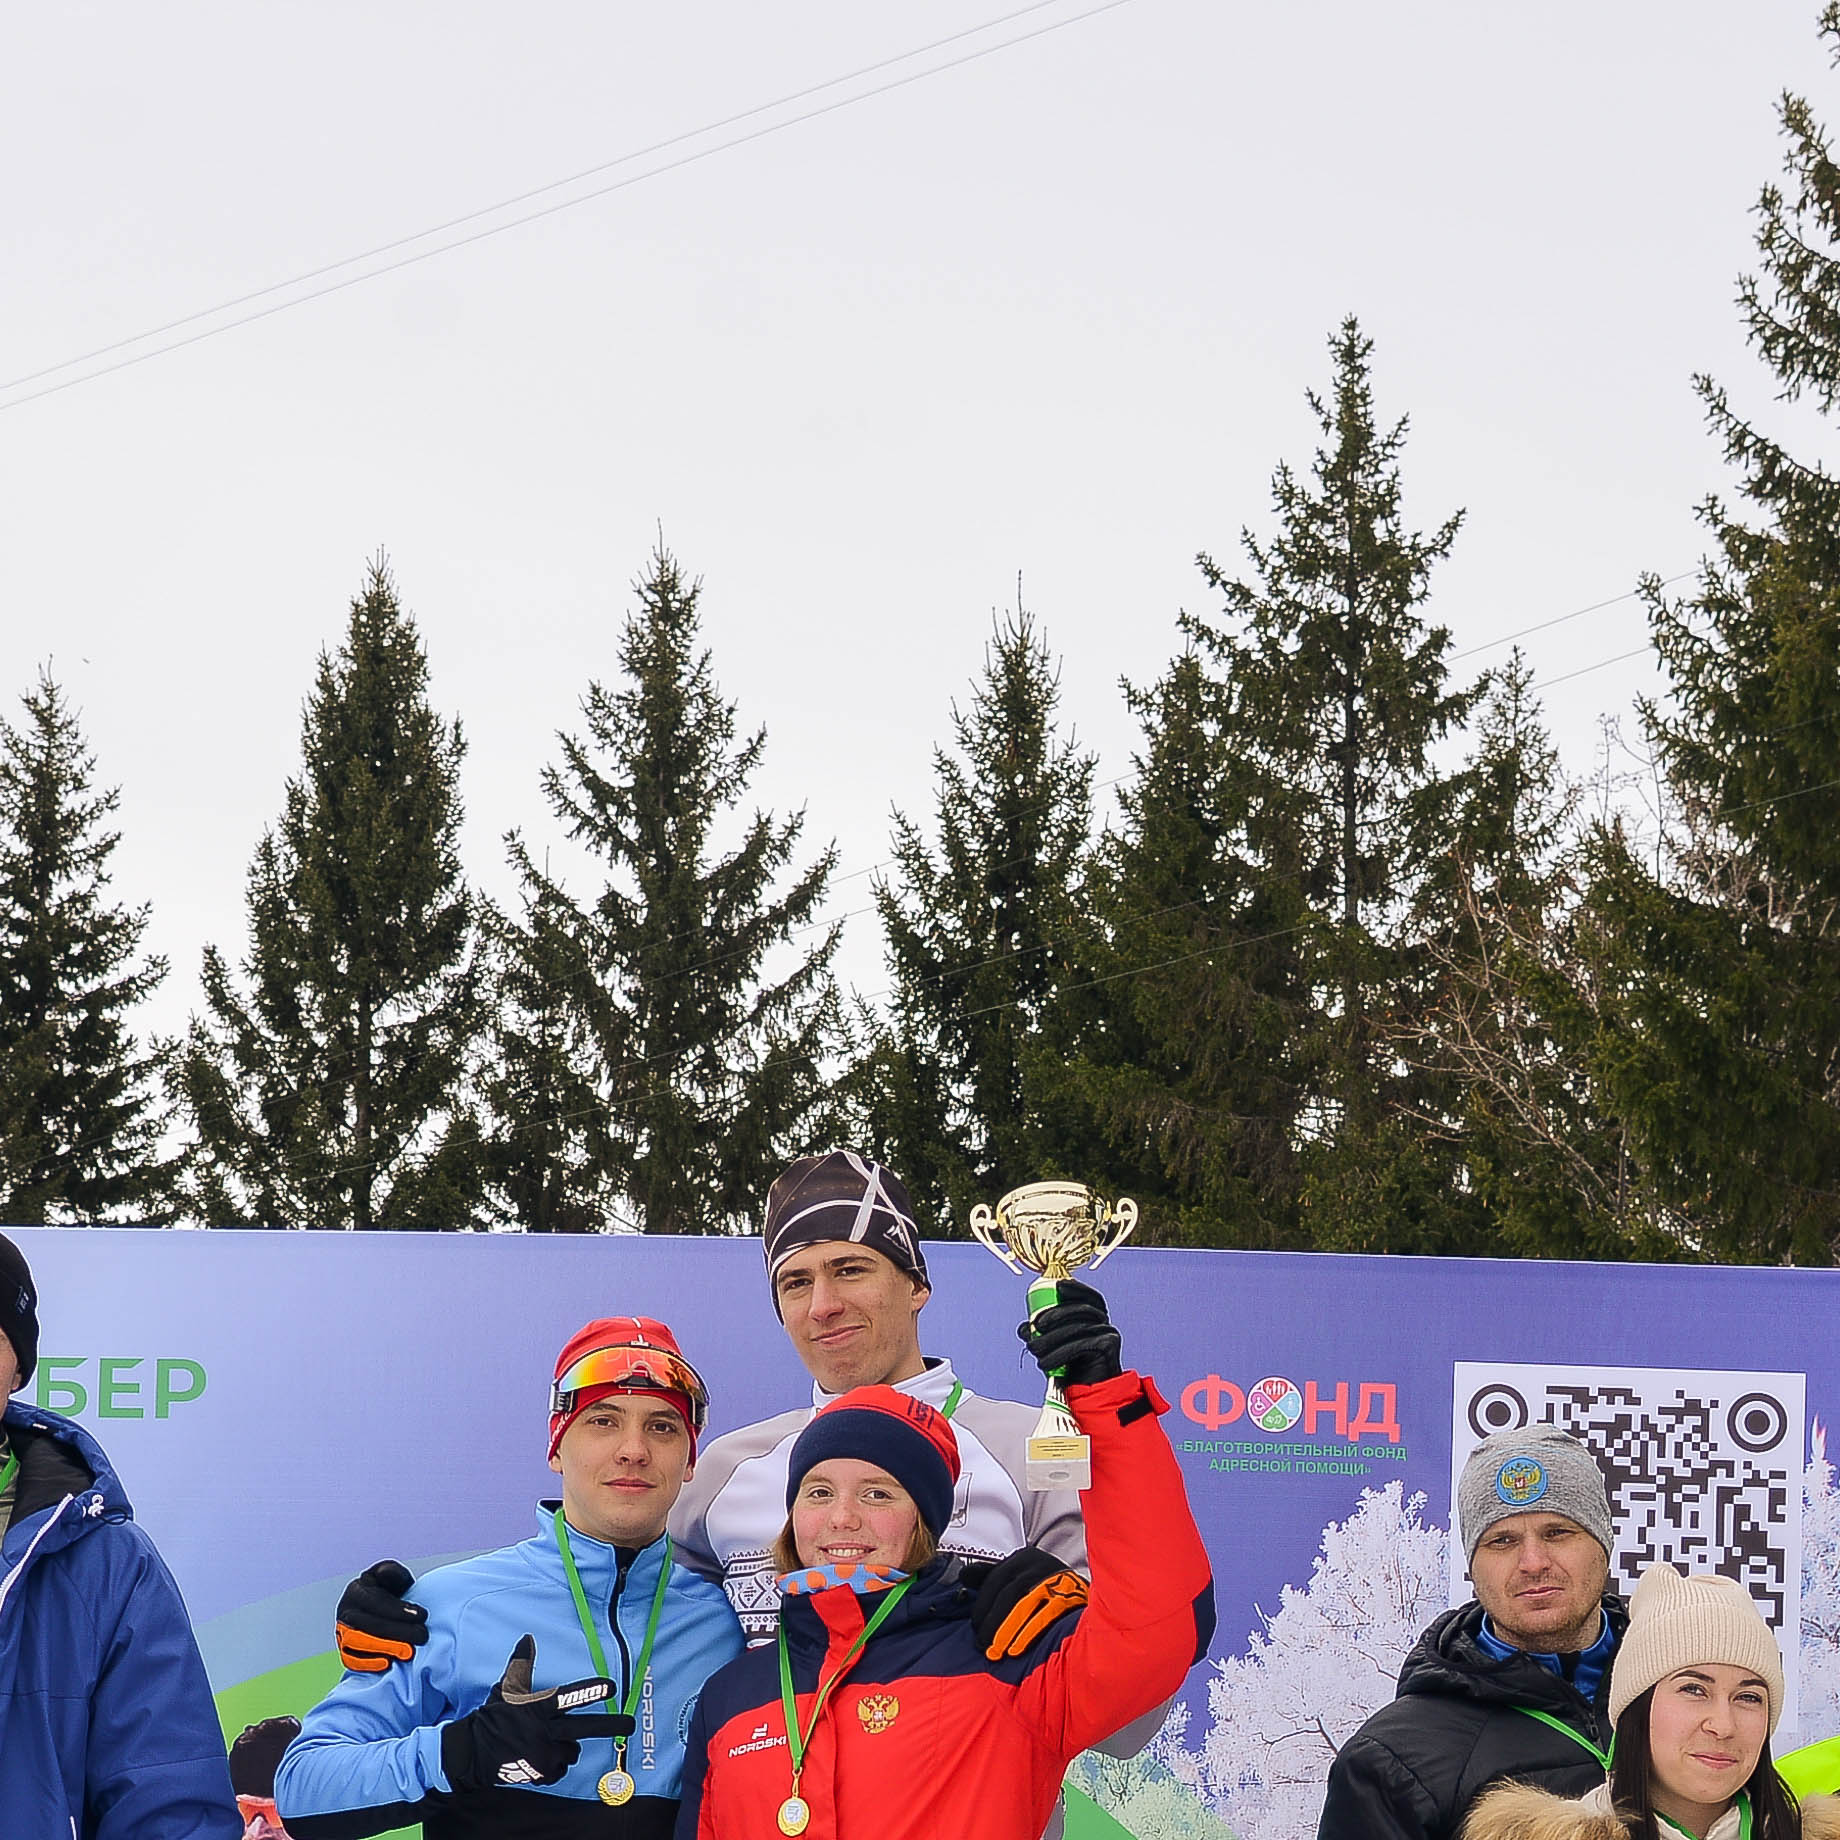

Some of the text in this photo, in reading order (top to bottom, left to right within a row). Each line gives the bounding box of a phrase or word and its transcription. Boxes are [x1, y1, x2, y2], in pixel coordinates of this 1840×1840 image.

[37, 1357, 208, 1420] БЕР
[1362, 1446, 1407, 1461] ФОНД
[1209, 1458, 1291, 1473] АДРЕСНОЙ
[642, 1666, 656, 1770] NORDSKI
[728, 1735, 787, 1758] NORDSKI
